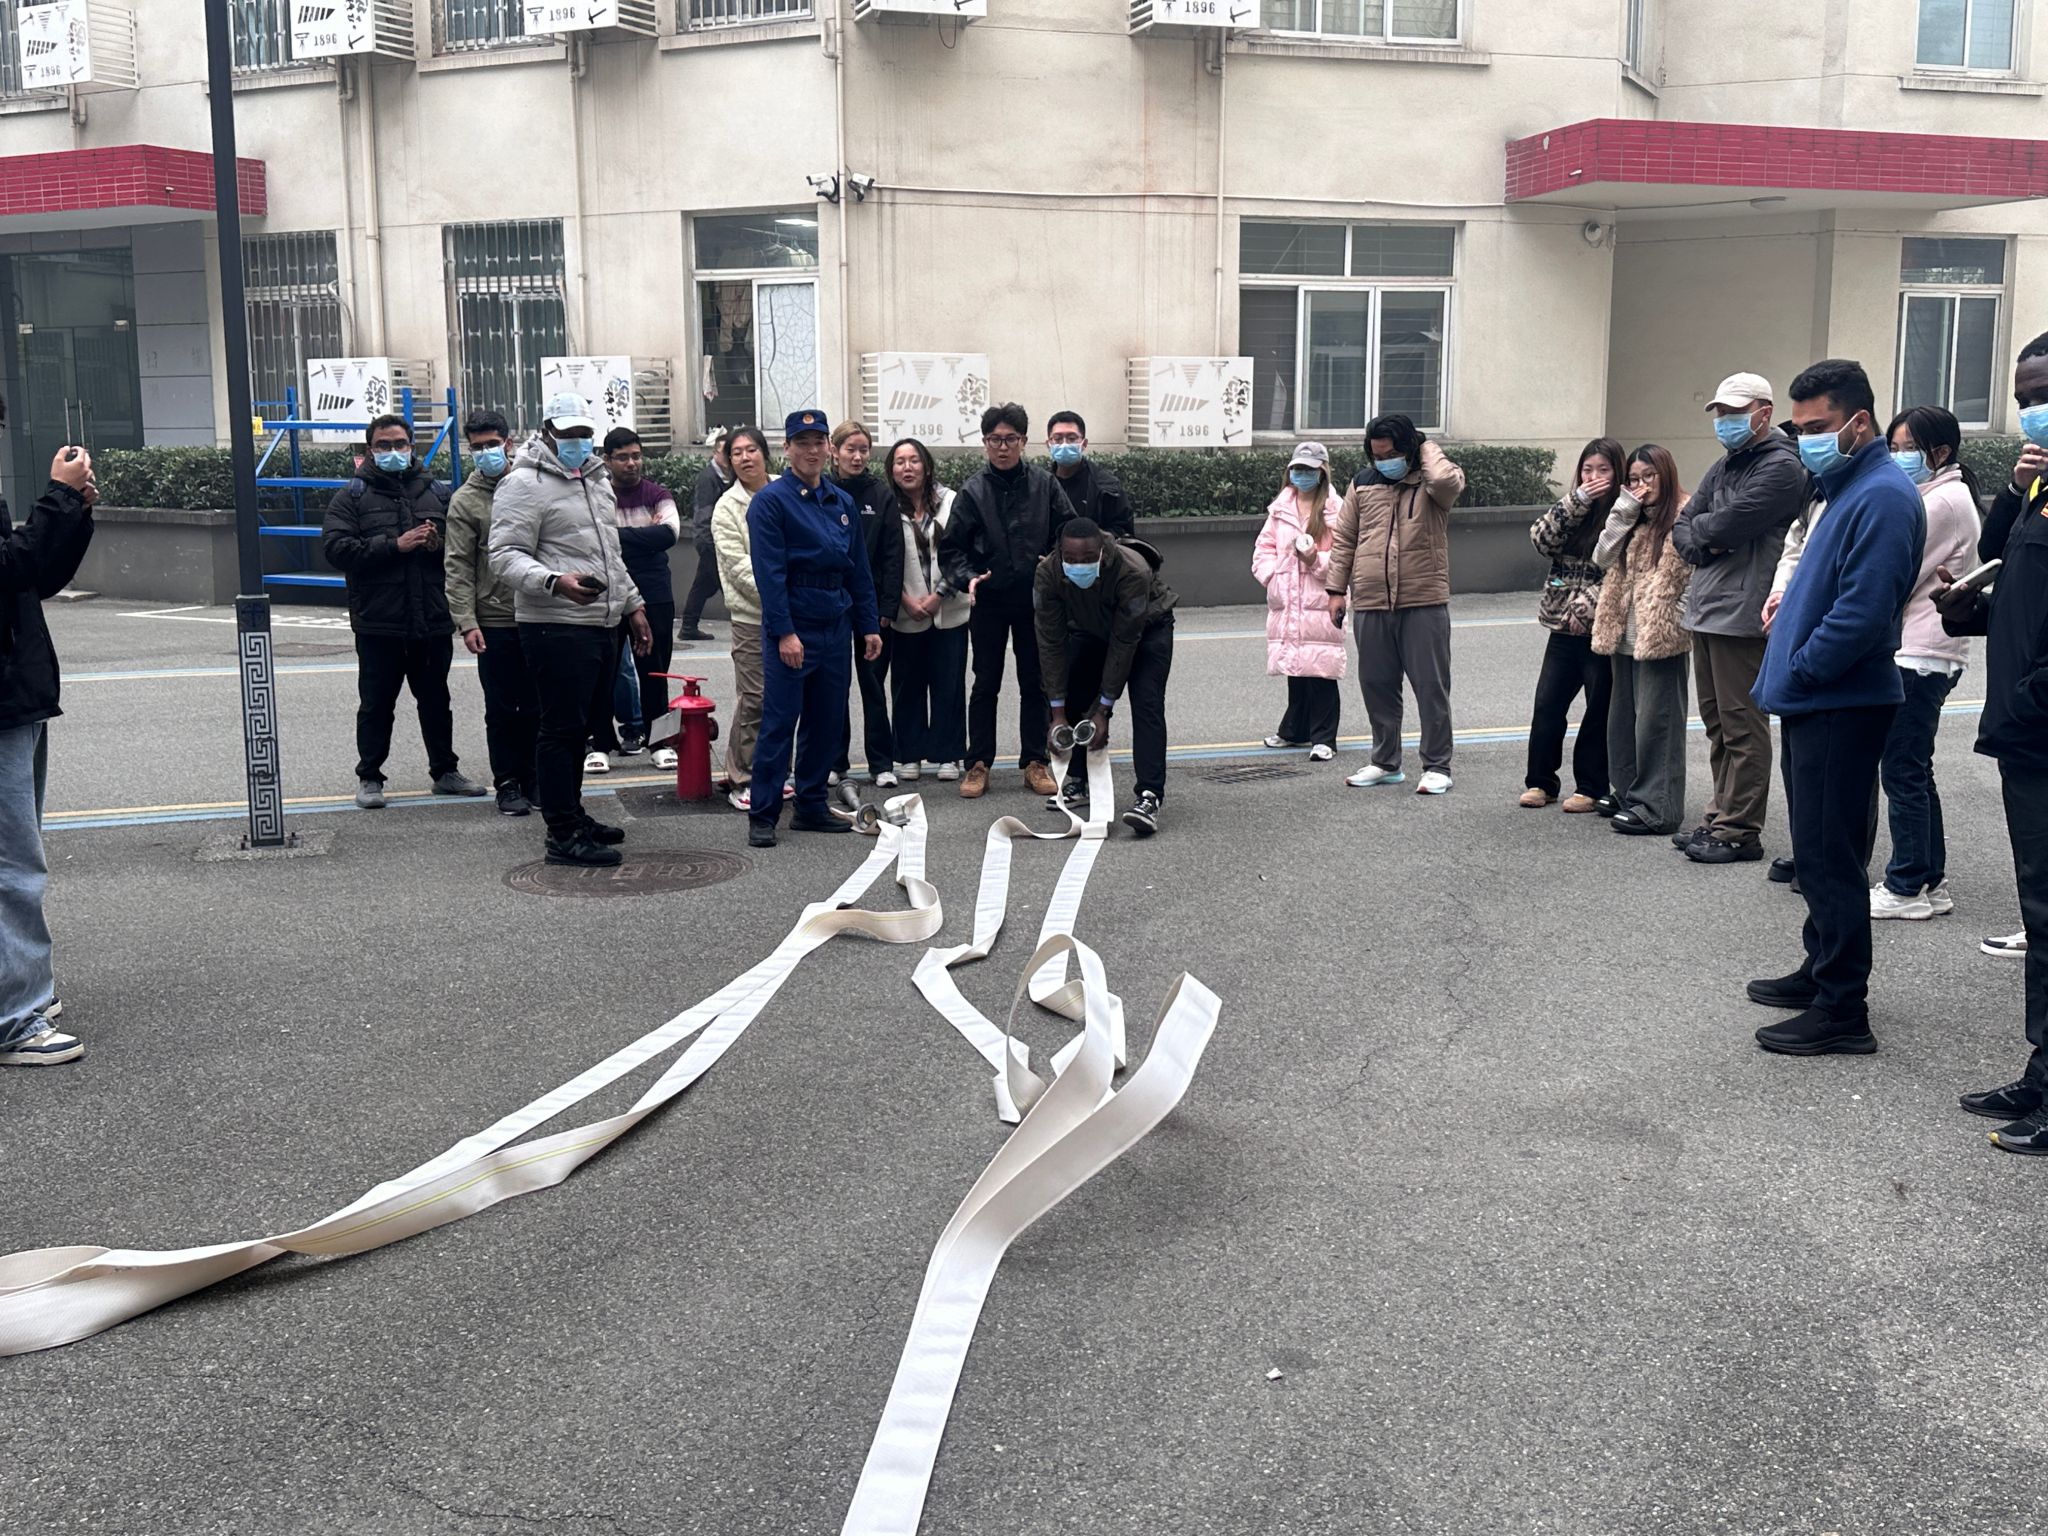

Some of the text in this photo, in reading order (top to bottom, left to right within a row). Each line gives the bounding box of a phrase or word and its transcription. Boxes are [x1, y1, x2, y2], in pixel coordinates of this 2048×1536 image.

[549, 7, 576, 21] 1896
[1185, 1, 1215, 14] 1896
[314, 33, 338, 46] 1896
[911, 424, 943, 436] 1896
[1179, 425, 1209, 437] 1896
[568, 843, 588, 857] N
